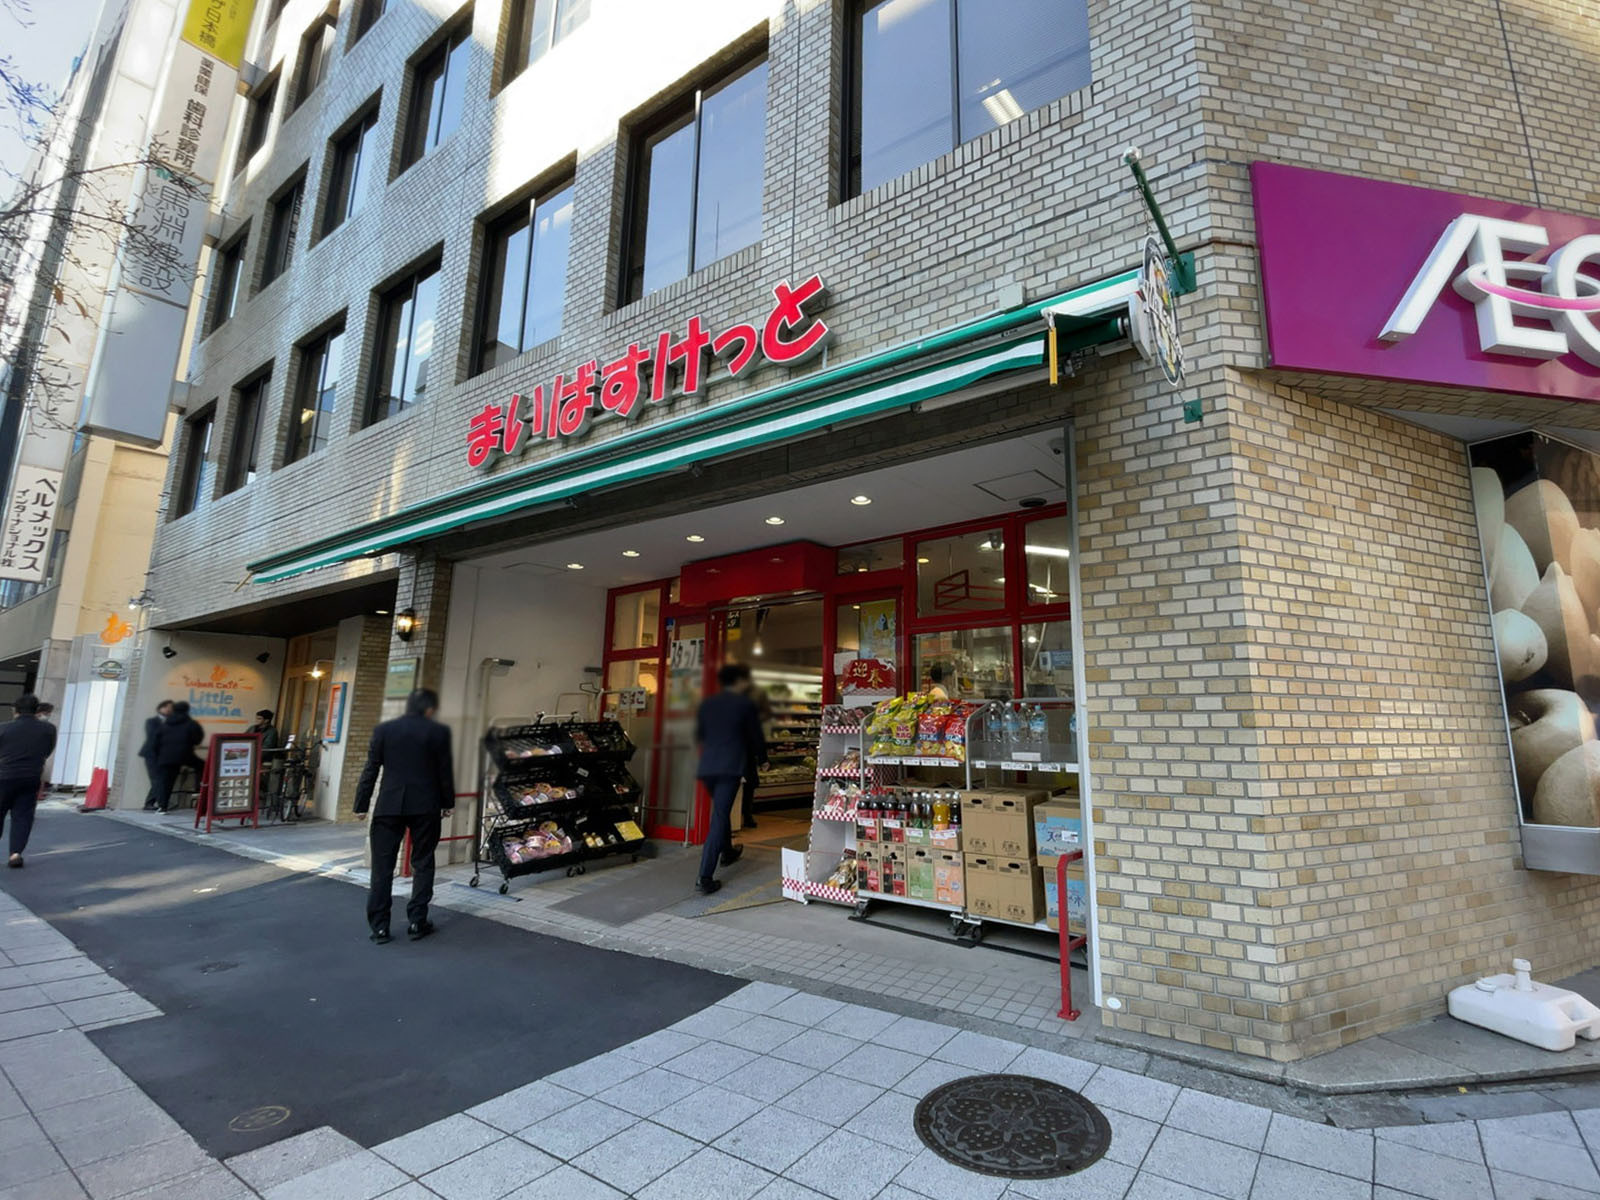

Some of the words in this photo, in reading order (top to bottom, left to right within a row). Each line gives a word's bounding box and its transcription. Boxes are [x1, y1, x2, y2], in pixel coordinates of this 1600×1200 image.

[465, 272, 831, 470] まいばすけっと
[18, 478, 58, 572] ベルメックス
[852, 661, 884, 688] 迎春
